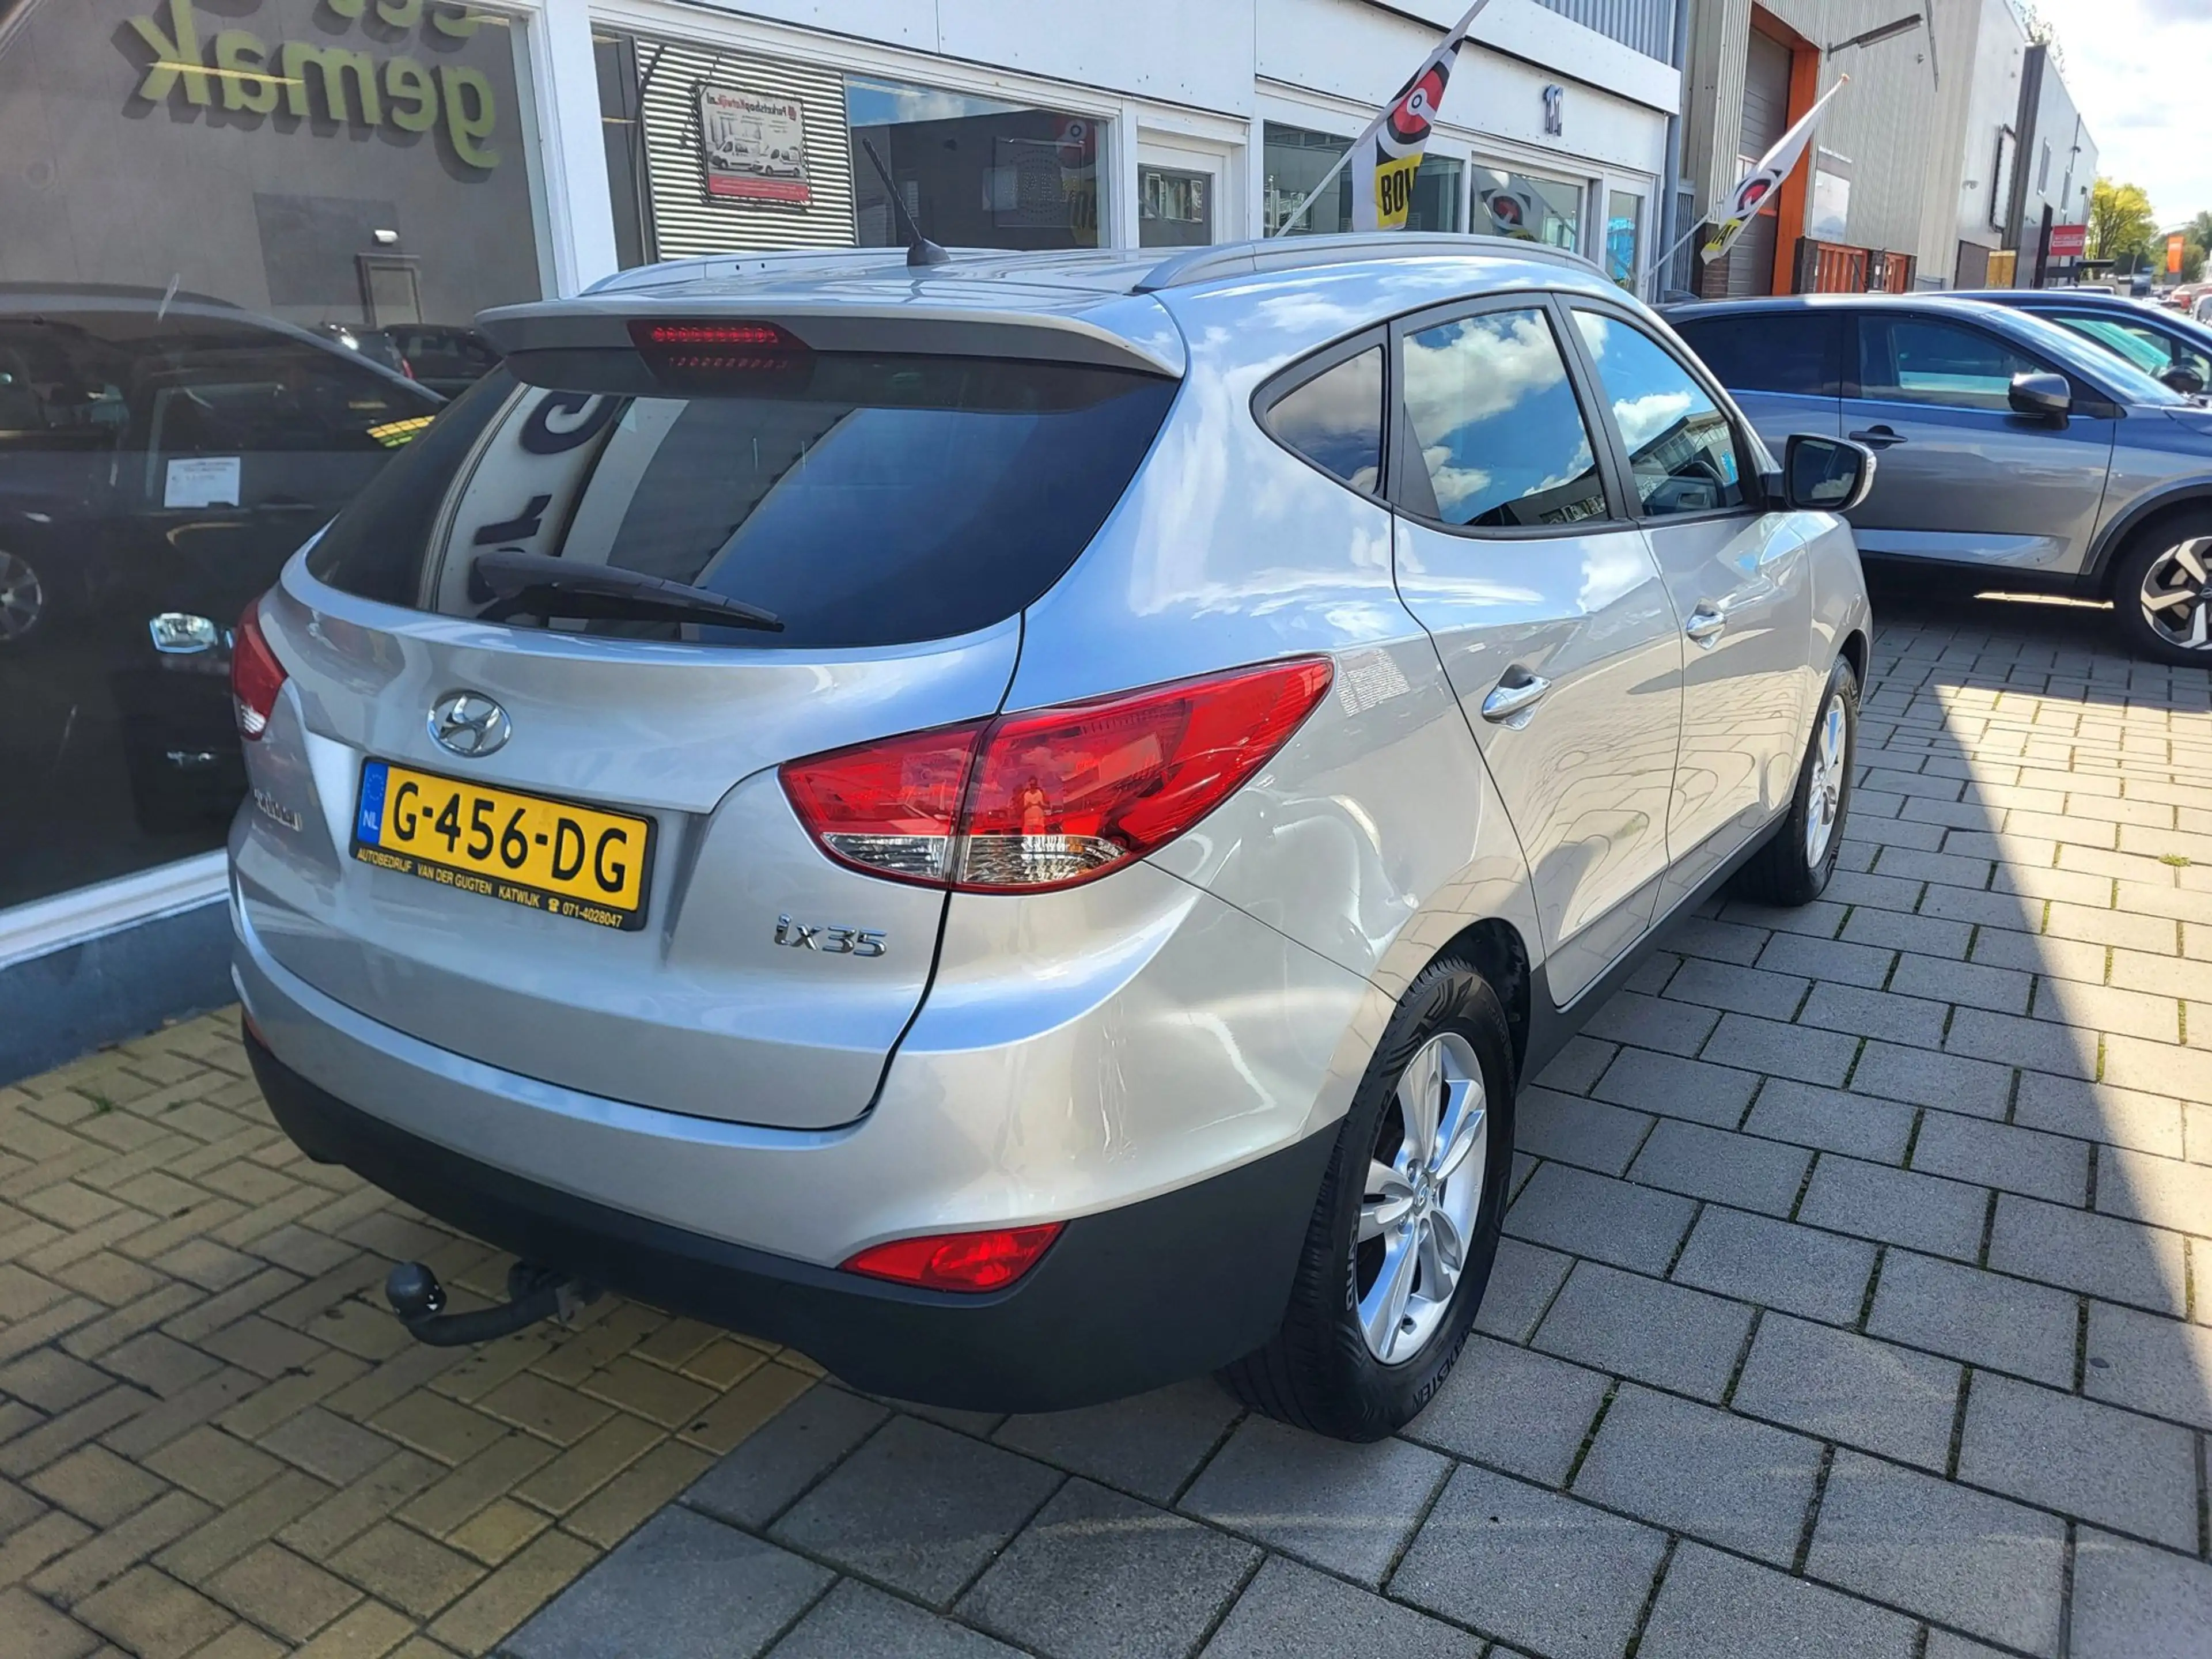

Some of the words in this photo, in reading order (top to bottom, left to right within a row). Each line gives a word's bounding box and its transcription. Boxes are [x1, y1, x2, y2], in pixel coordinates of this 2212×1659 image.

[362, 809, 379, 831] NL
[393, 781, 627, 893] G-456-DG
[356, 848, 412, 873] AUTOBEDRIJF
[417, 863, 434, 880] VAN
[435, 869, 454, 885] DER
[454, 875, 493, 895] GUGTEN
[498, 885, 541, 907] KATWIJK
[562, 902, 623, 927] 071-4028047
[774, 913, 887, 957] ix35
